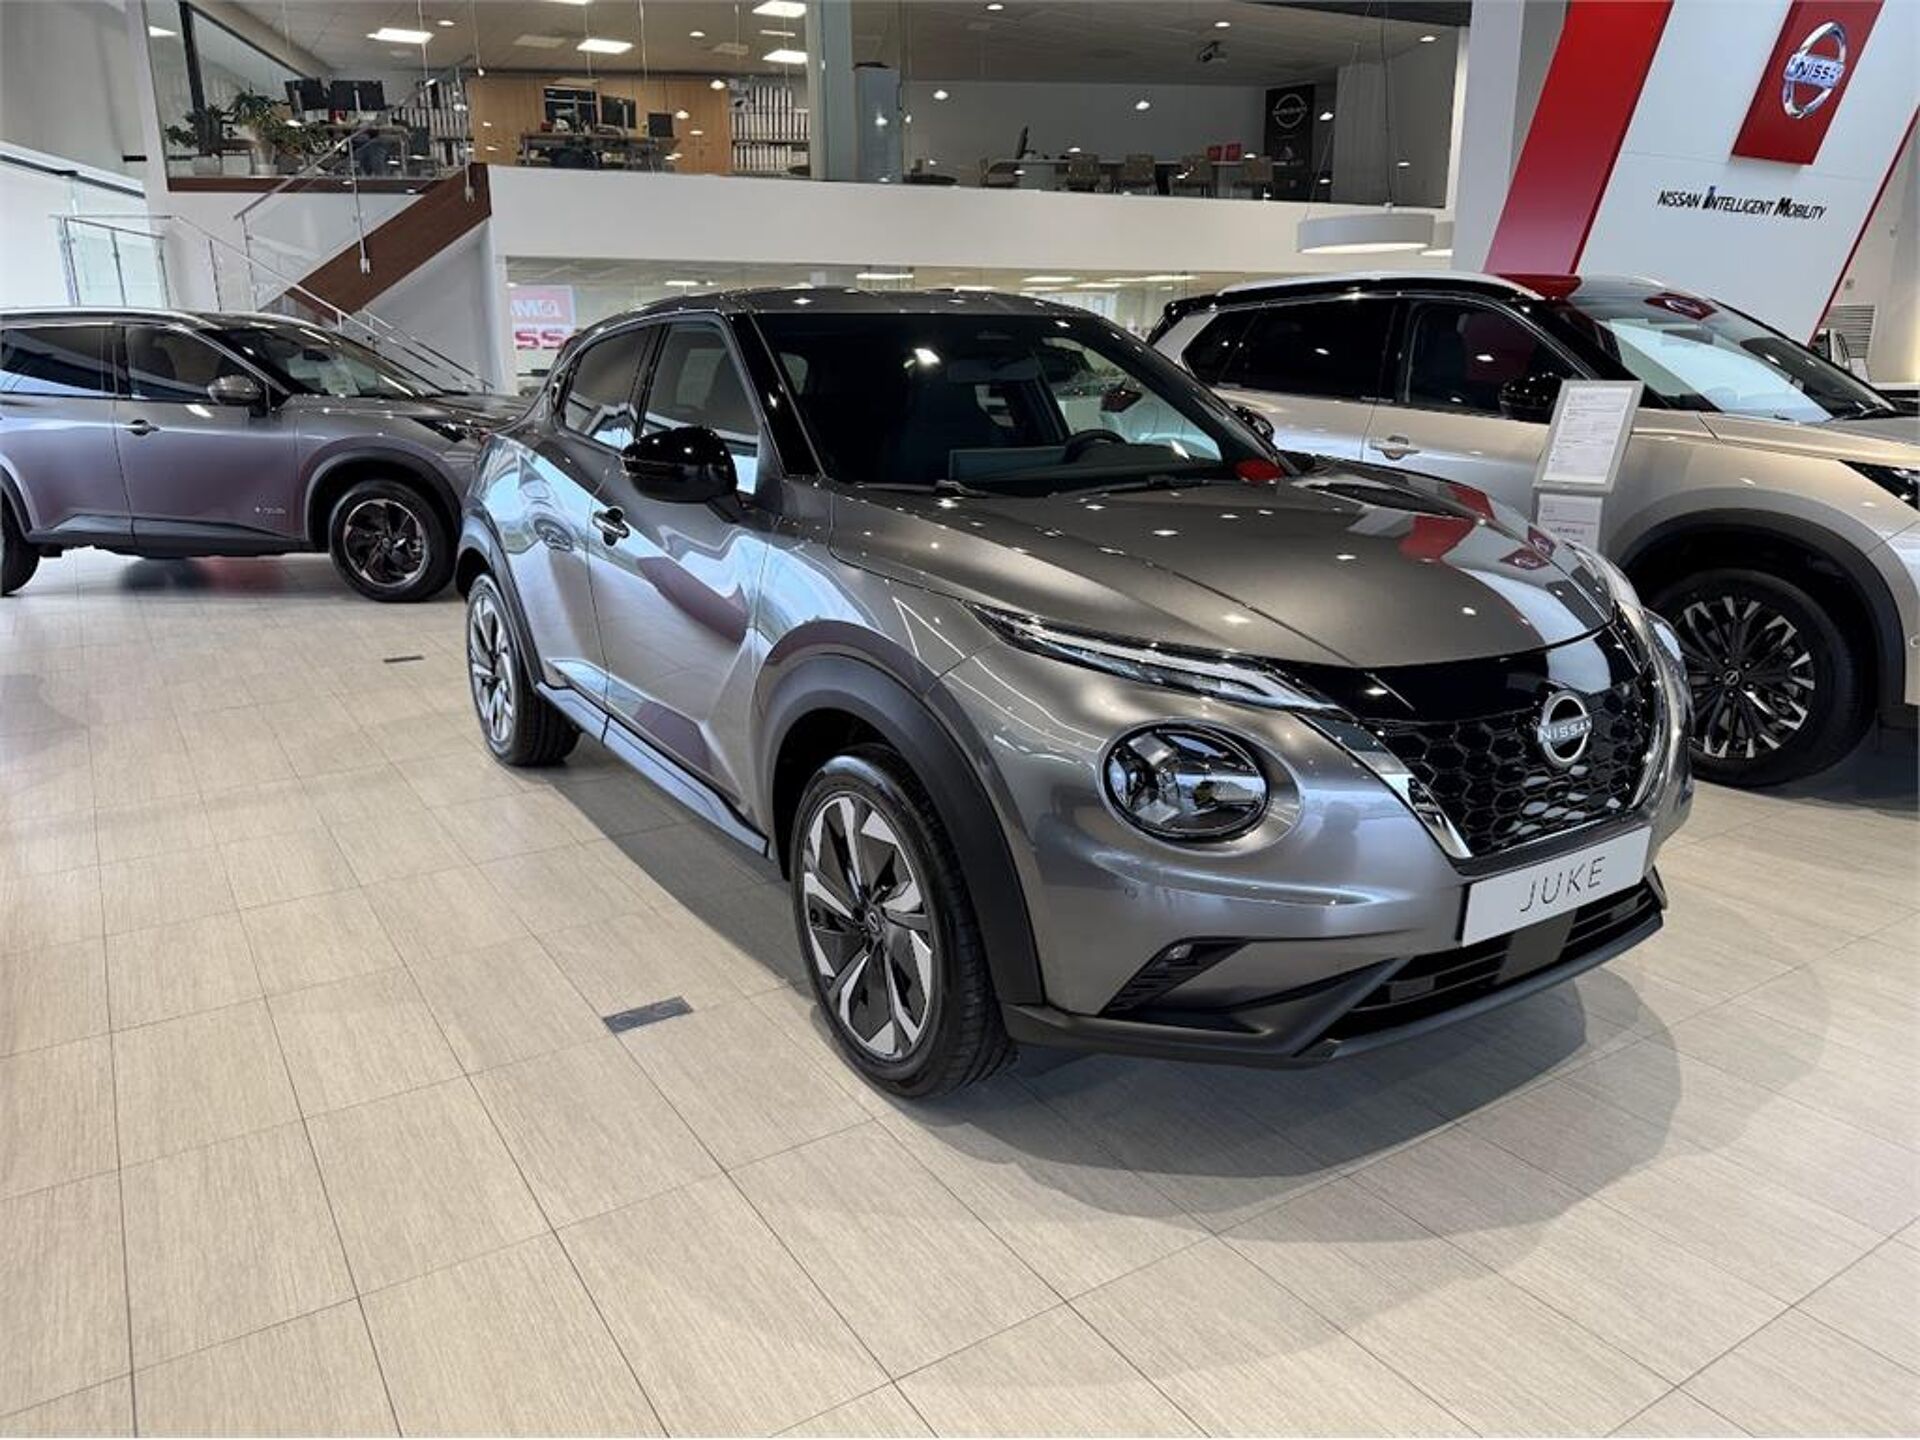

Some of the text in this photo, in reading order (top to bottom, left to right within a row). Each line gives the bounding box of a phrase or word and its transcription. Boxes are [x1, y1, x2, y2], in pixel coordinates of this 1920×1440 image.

[1658, 190, 1701, 208] NISSAN
[1774, 197, 1827, 219] MOBILITY
[1538, 719, 1593, 741] NISSAN
[1520, 856, 1606, 912] JUKE
